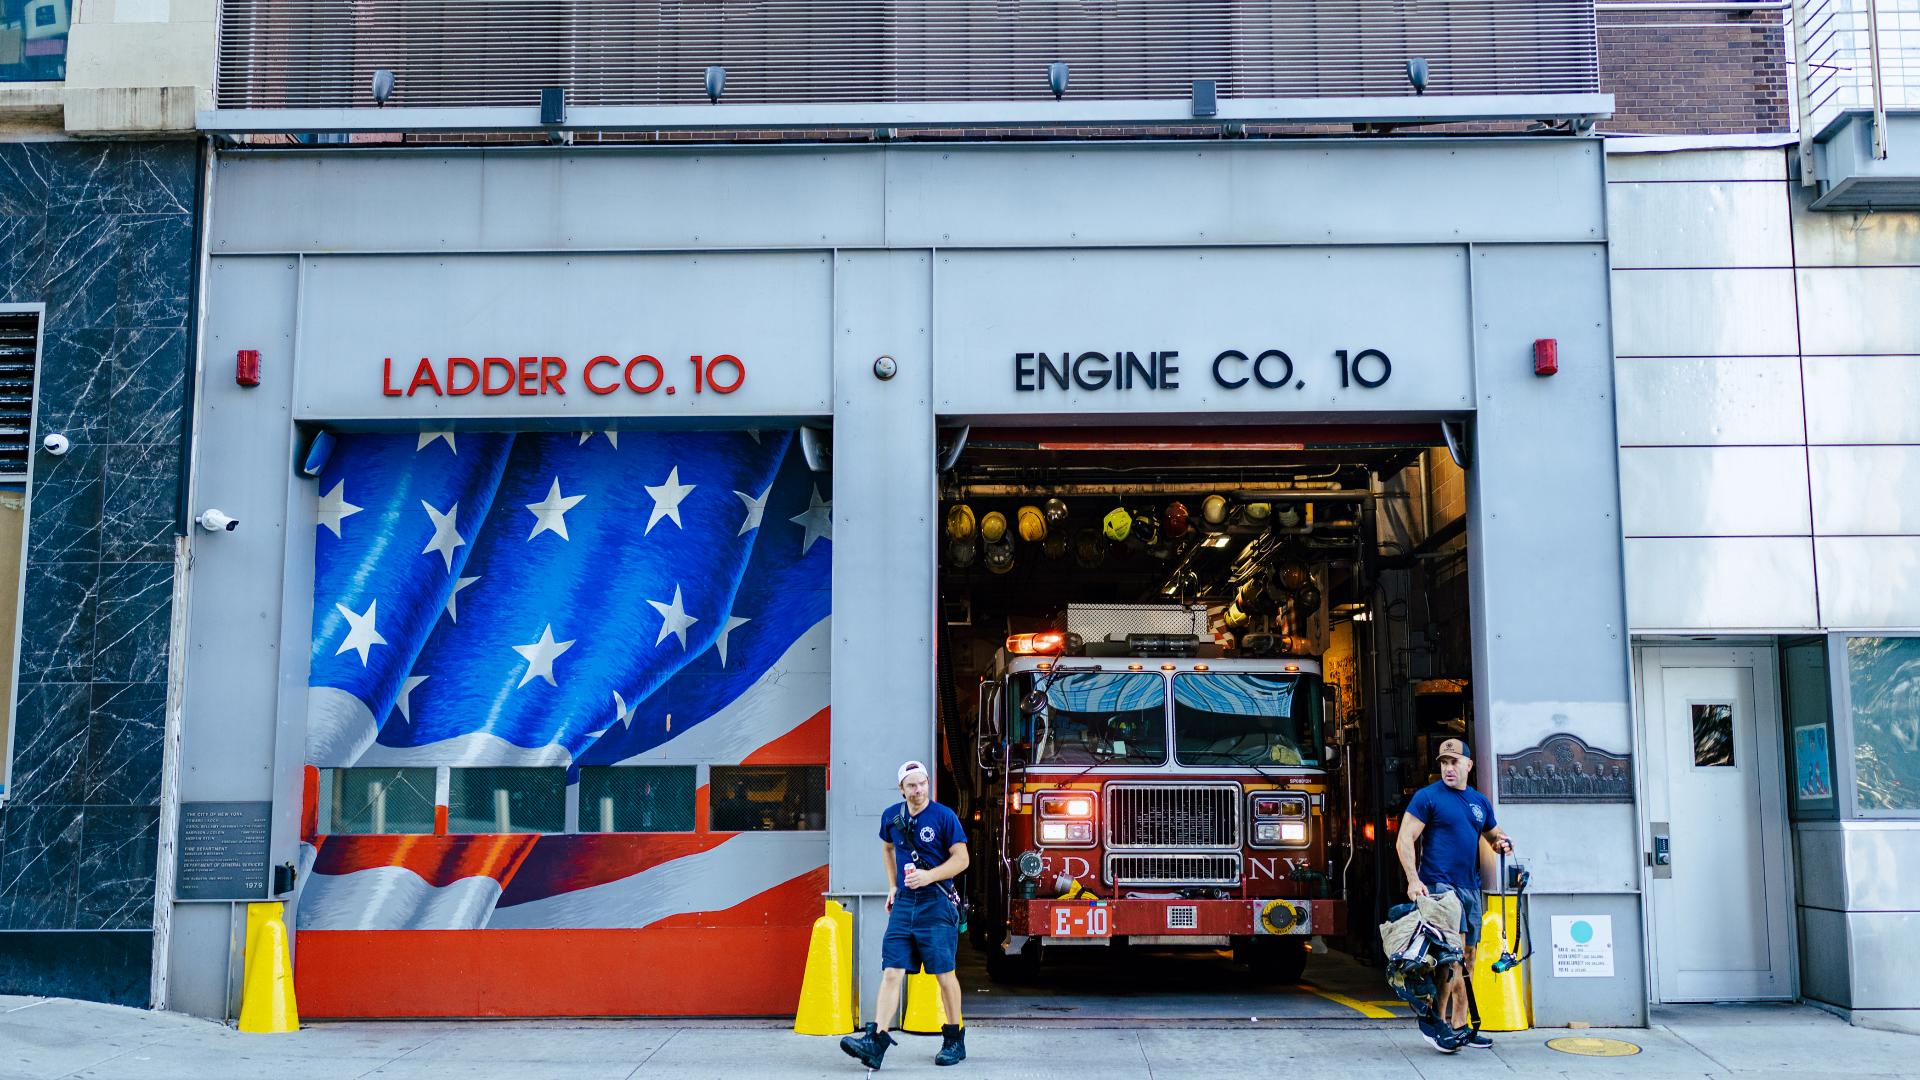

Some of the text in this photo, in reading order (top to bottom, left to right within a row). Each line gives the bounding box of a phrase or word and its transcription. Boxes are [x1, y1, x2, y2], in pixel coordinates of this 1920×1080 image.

[383, 354, 746, 396] LADDER CO. 10
[1015, 349, 1392, 391] ENGINE CO. 10
[1055, 908, 1107, 935] E-10
